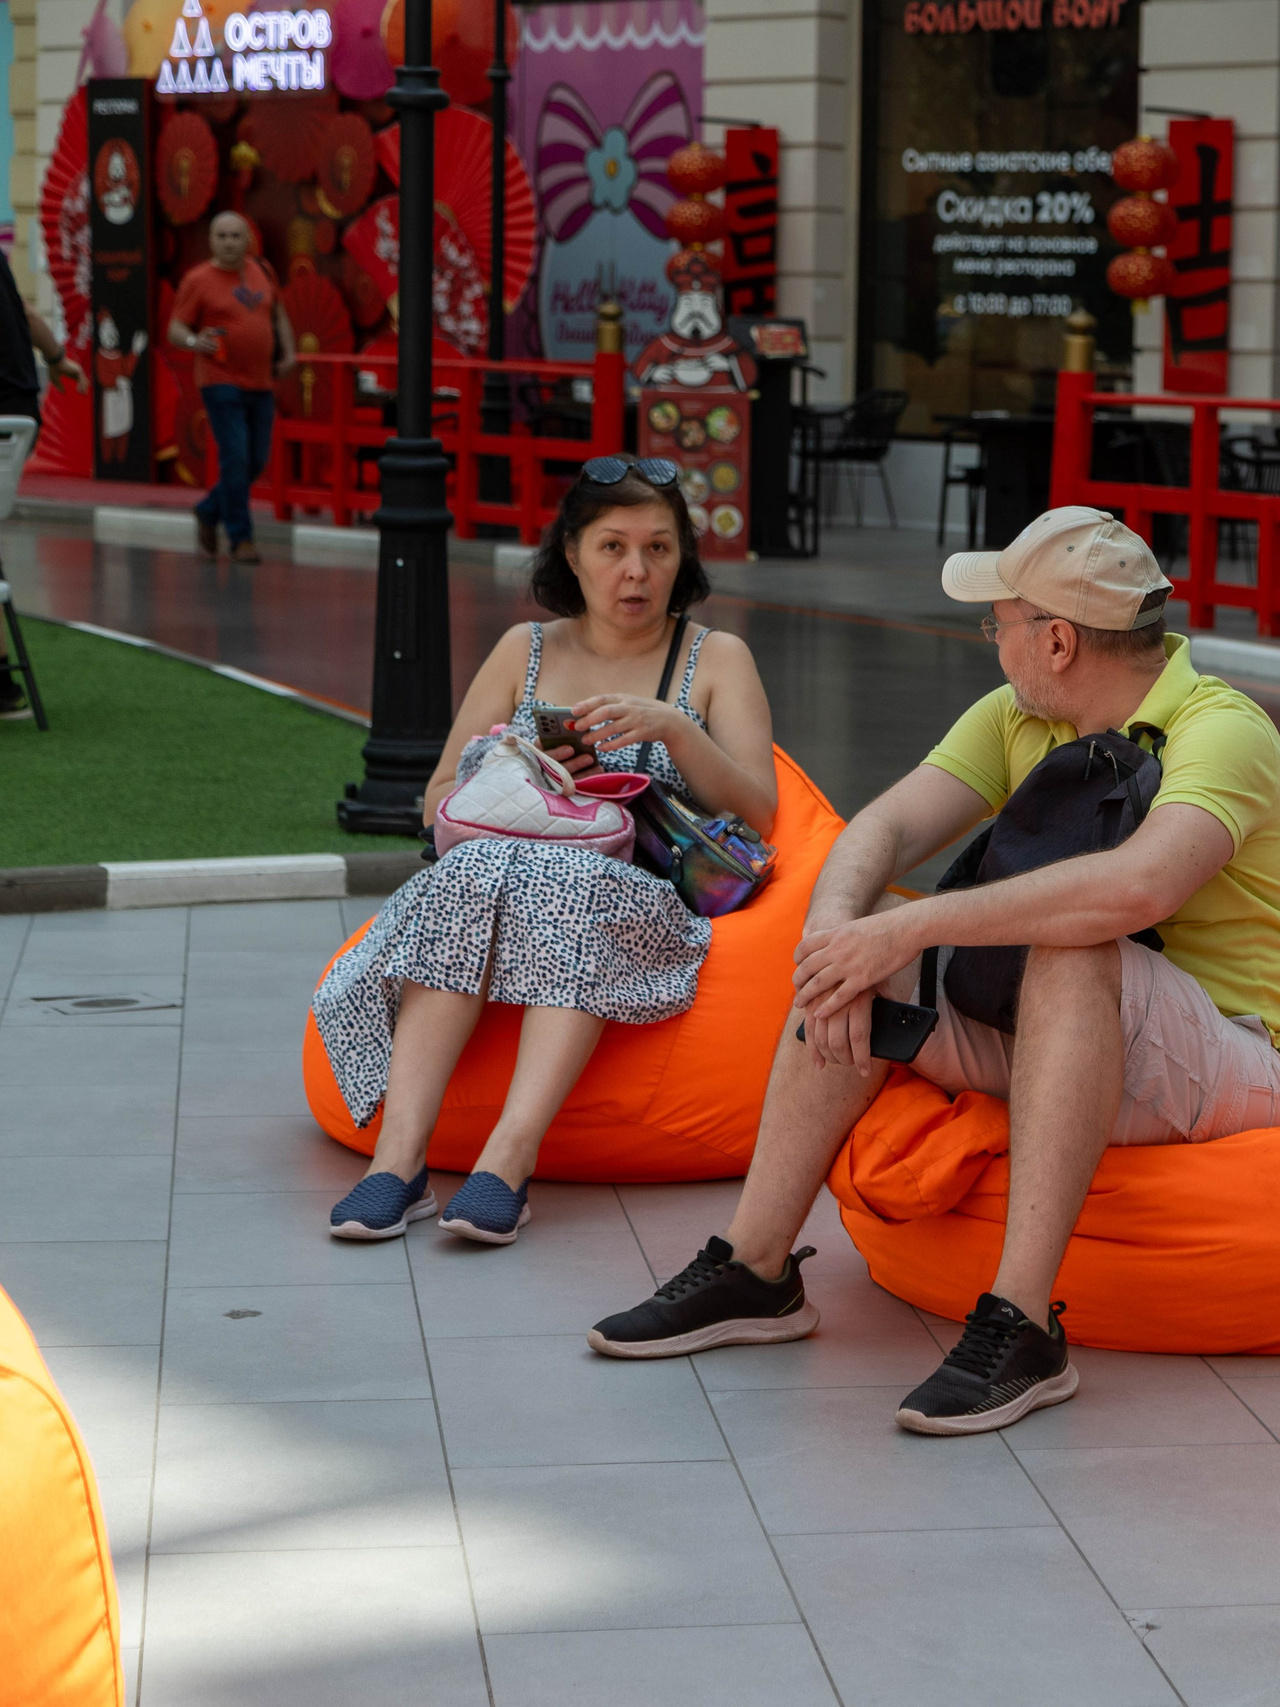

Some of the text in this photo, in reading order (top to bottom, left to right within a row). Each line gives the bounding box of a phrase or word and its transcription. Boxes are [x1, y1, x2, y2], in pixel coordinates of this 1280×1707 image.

[224, 9, 332, 51] ОСТРОВ
[232, 50, 325, 91] МЕЧТЫ
[901, 146, 1114, 175] Сытные азиатские обе
[936, 189, 1095, 228] Скидка 20%
